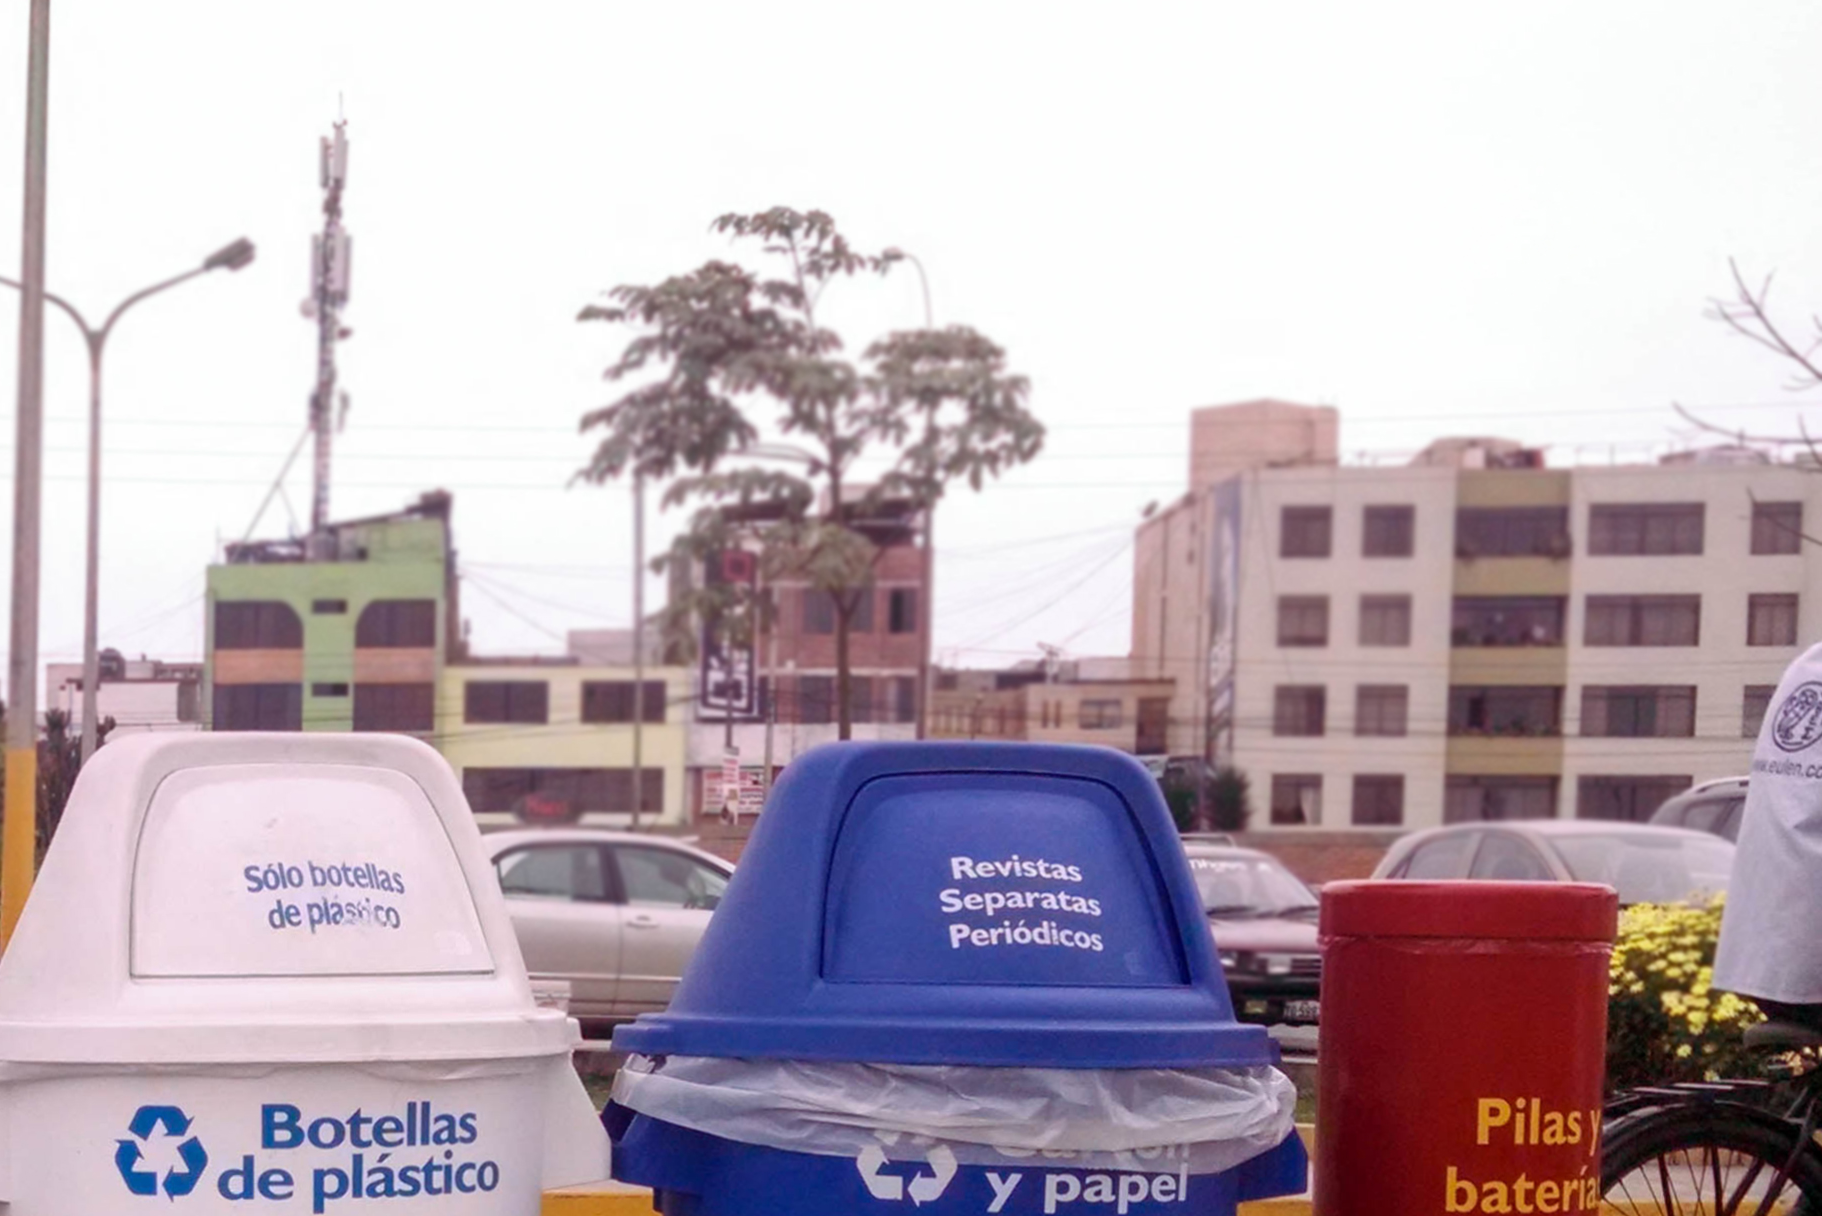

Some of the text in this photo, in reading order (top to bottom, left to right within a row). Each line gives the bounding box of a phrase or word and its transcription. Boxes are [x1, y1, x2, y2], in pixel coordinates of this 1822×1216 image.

[244, 860, 405, 894] Sólo botellas
[950, 854, 1083, 882] Revistas
[268, 899, 303, 930] de
[939, 887, 1103, 917] Separatas
[948, 919, 1105, 951] Periódicos
[261, 1101, 478, 1150] Botellas
[1476, 1097, 1601, 1157] Pilas y
[217, 1149, 500, 1214] de plástico
[985, 1163, 1189, 1215] y papel
[1445, 1165, 1600, 1214] batería
